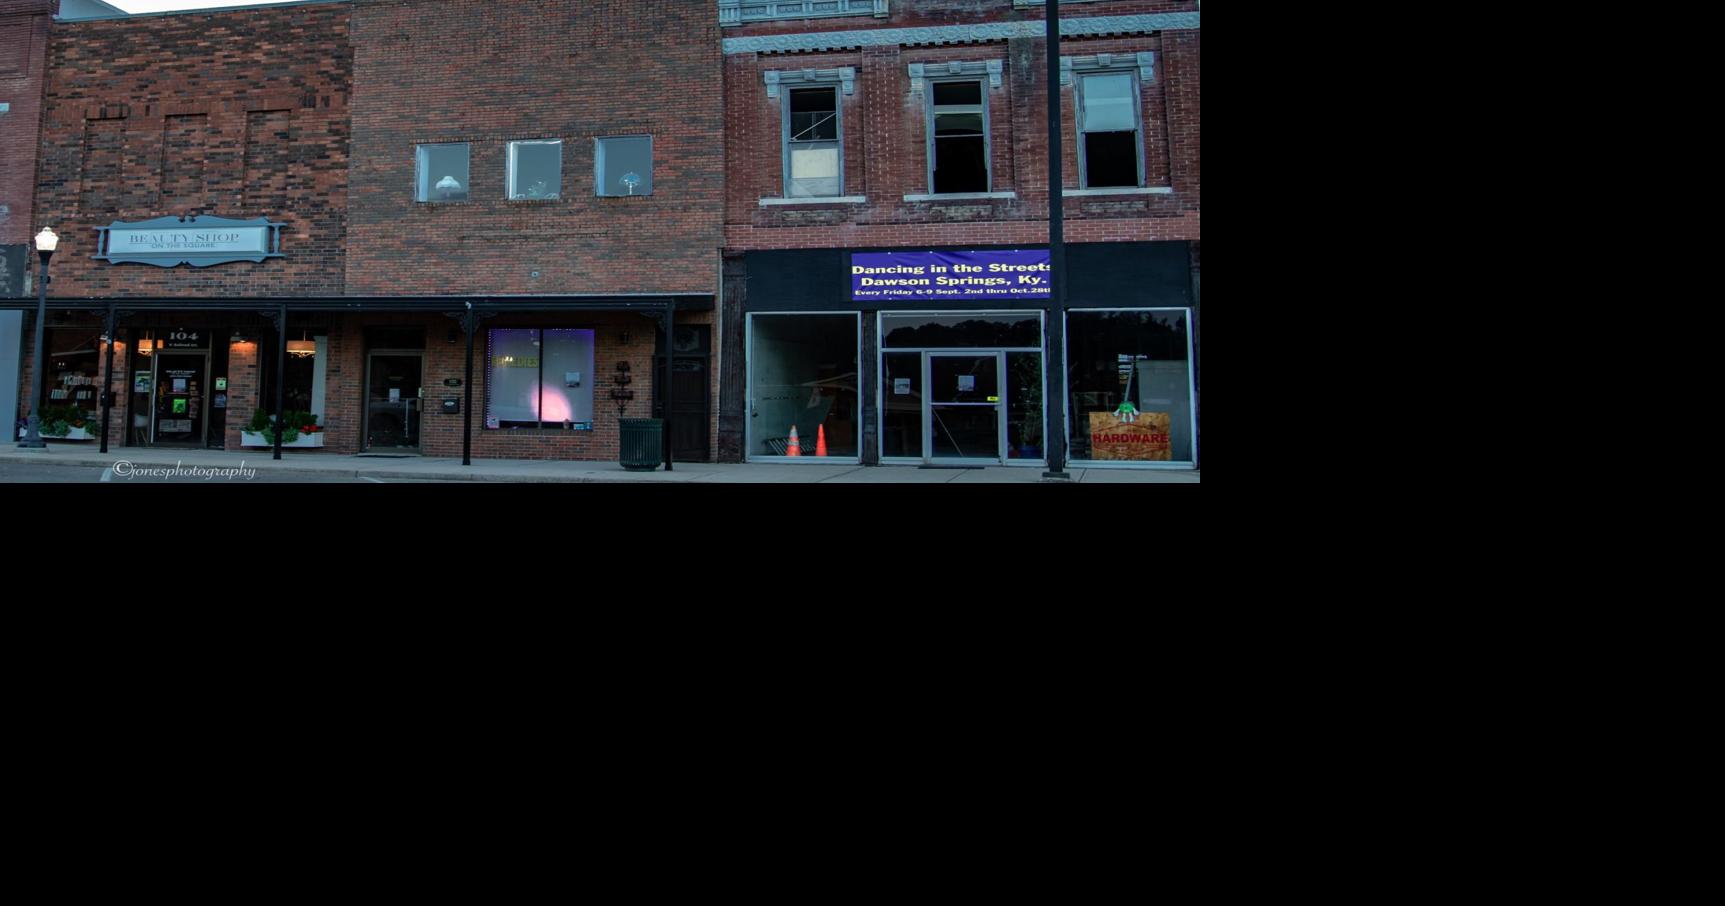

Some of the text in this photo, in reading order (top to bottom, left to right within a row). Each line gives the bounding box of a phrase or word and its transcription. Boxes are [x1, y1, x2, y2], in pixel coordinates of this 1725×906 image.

[130, 232, 239, 243] BEAUTY SHOP
[851, 264, 925, 275] Dancing
[930, 264, 947, 273] in
[953, 263, 983, 273] the
[861, 275, 1047, 287] Dawson Springs, Ky.
[170, 331, 199, 341] 104
[1092, 433, 1168, 443] HARDWARE
